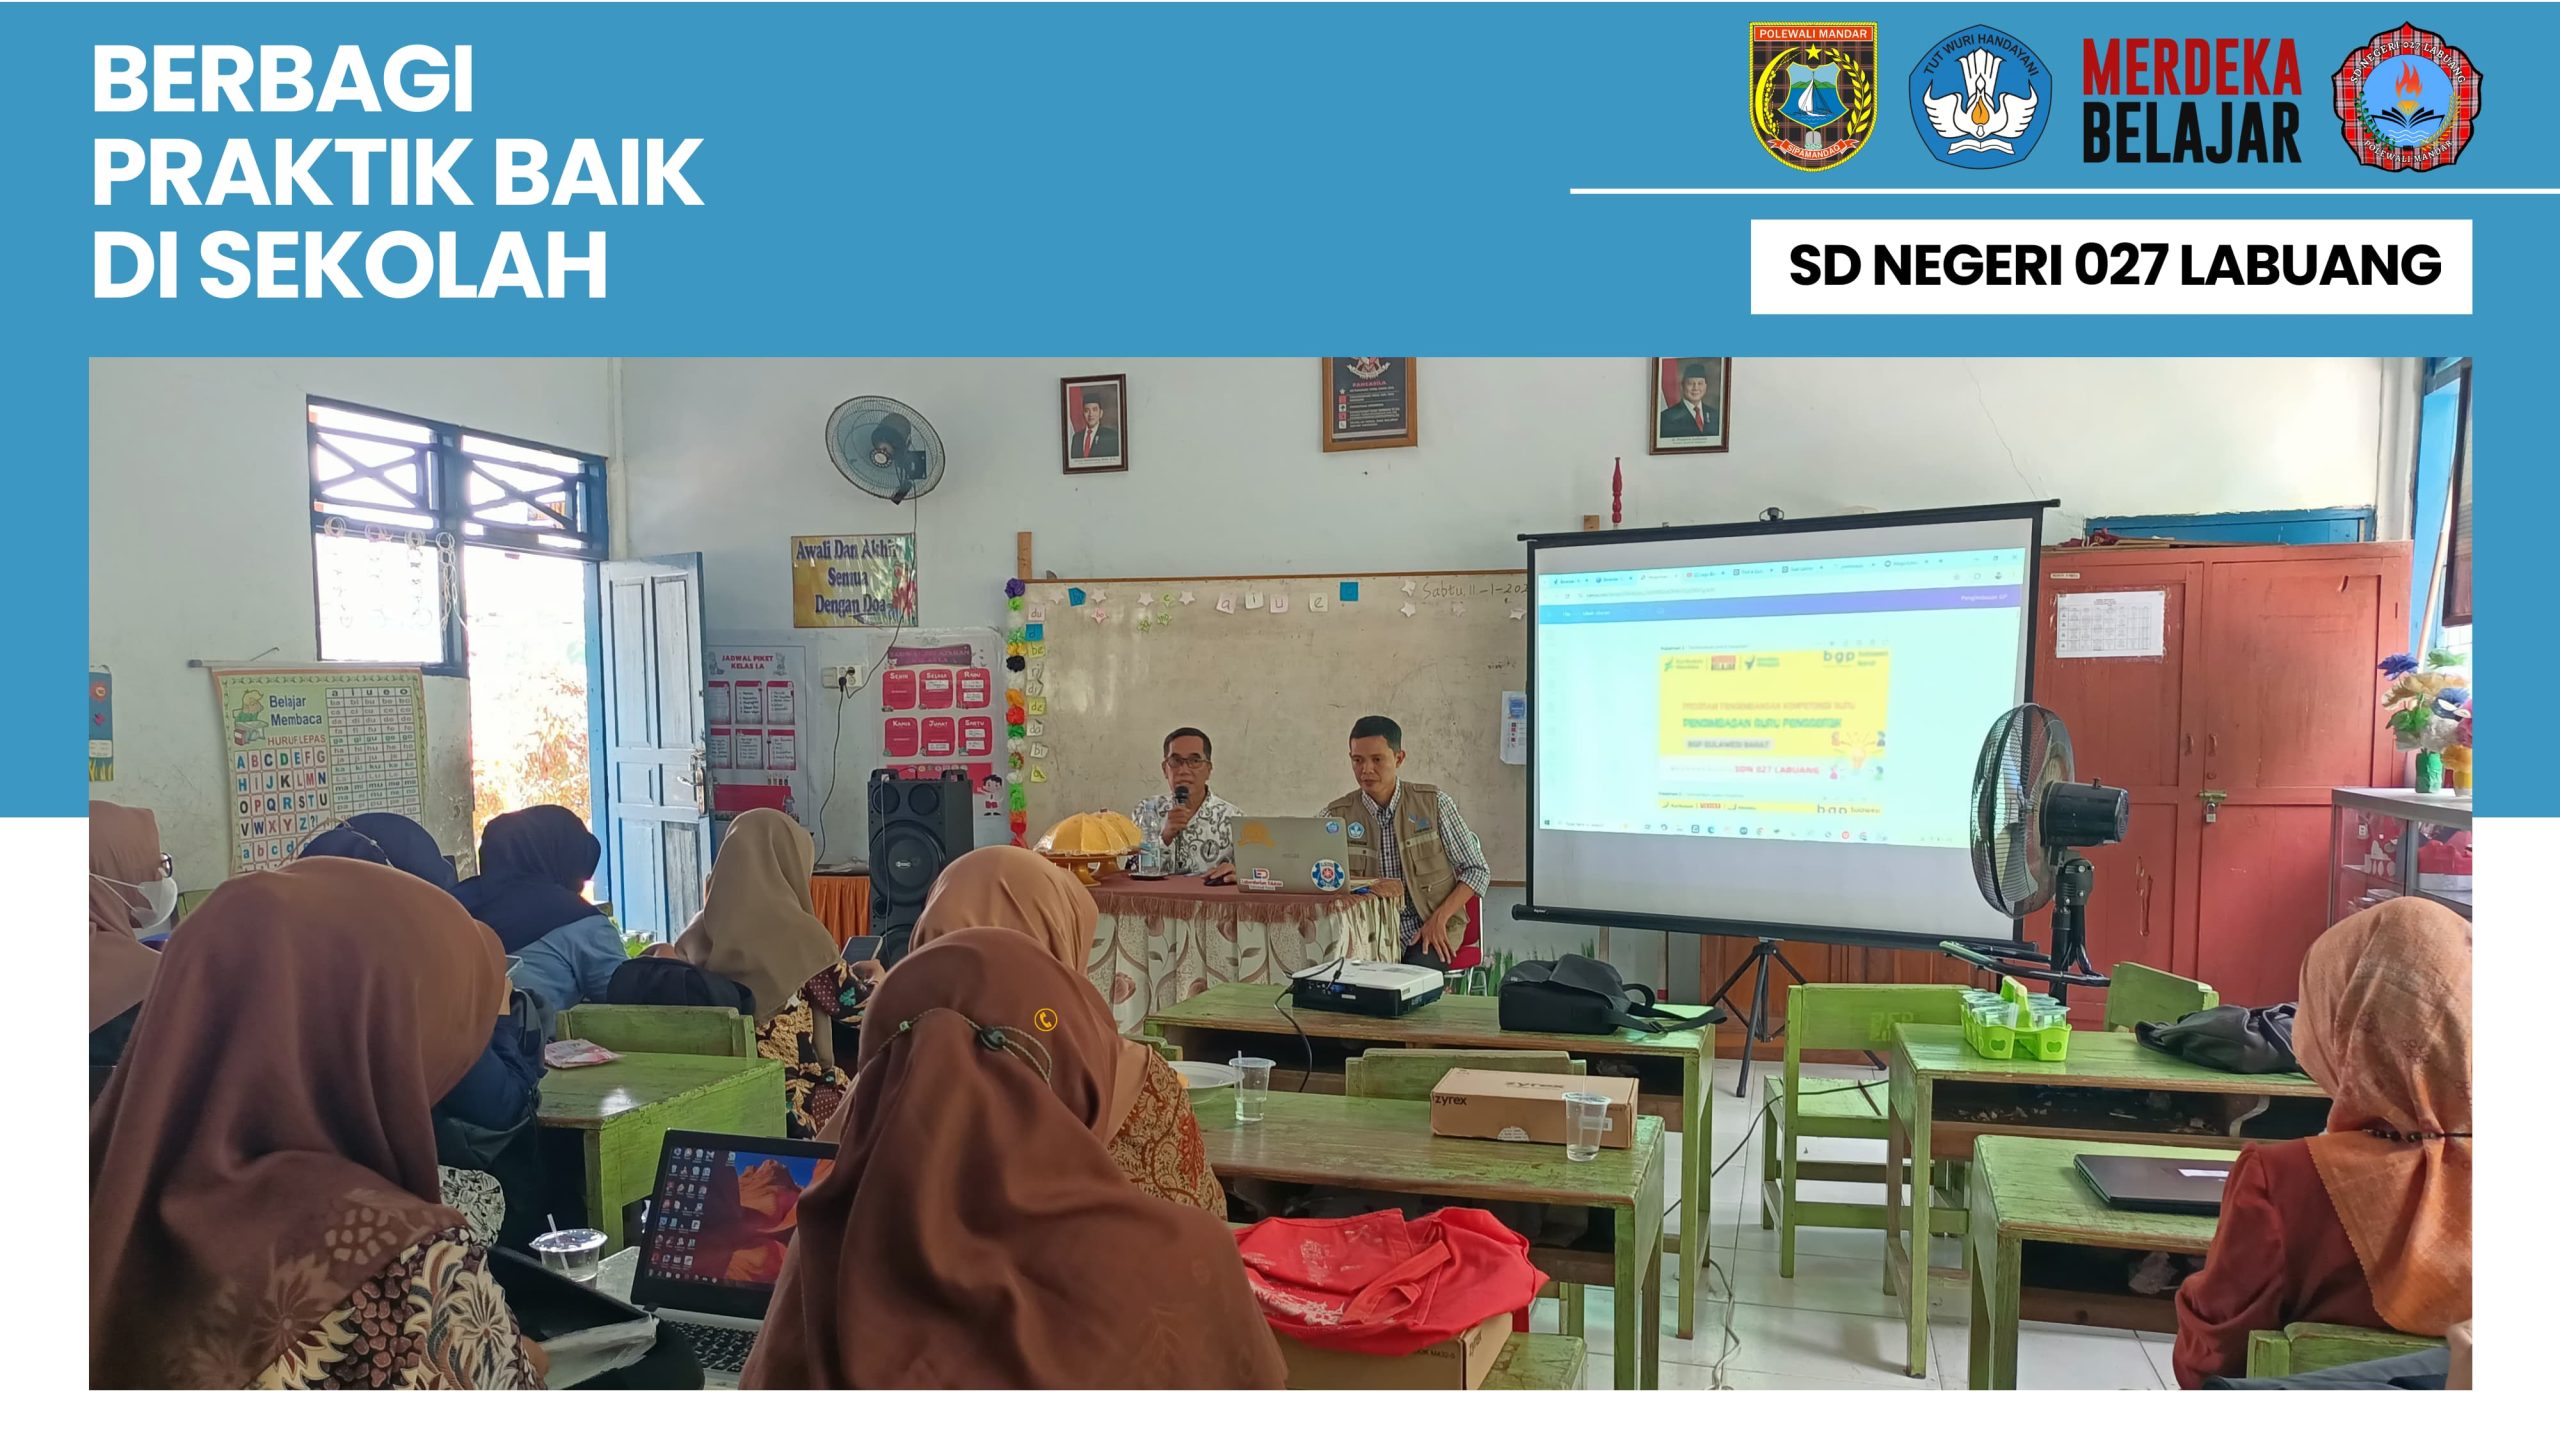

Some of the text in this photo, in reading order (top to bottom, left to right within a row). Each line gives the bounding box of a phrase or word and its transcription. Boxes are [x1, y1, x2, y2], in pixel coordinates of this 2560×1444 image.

[796, 540, 831, 560] Awali
[834, 540, 858, 559] Dan
[828, 567, 868, 587] Semua
[815, 594, 886, 618] Dengan Doa
[269, 695, 306, 710] Belajar
[271, 713, 322, 726] Membaca
[268, 734, 326, 746] HURUF LEPAS
[237, 750, 325, 769] A B C D E F G
[239, 778, 247, 791] H
[266, 776, 273, 789] J
[280, 774, 291, 788] K
[297, 774, 302, 786] L
[306, 773, 314, 786] M
[318, 772, 326, 785] N
[240, 801, 248, 814] O
[254, 800, 261, 812] P
[267, 798, 276, 811] Q
[283, 797, 292, 810] R
[299, 795, 305, 808] S
[308, 794, 314, 807] T
[319, 793, 328, 806] U
[241, 823, 249, 836] V
[253, 821, 264, 835] W
[268, 820, 277, 833] X
[283, 819, 292, 831] Y
[300, 817, 307, 830] Z
[243, 841, 294, 859] a b c d
[1506, 1081, 1564, 1089] zyrex
[1435, 1095, 1467, 1106] zyrex
